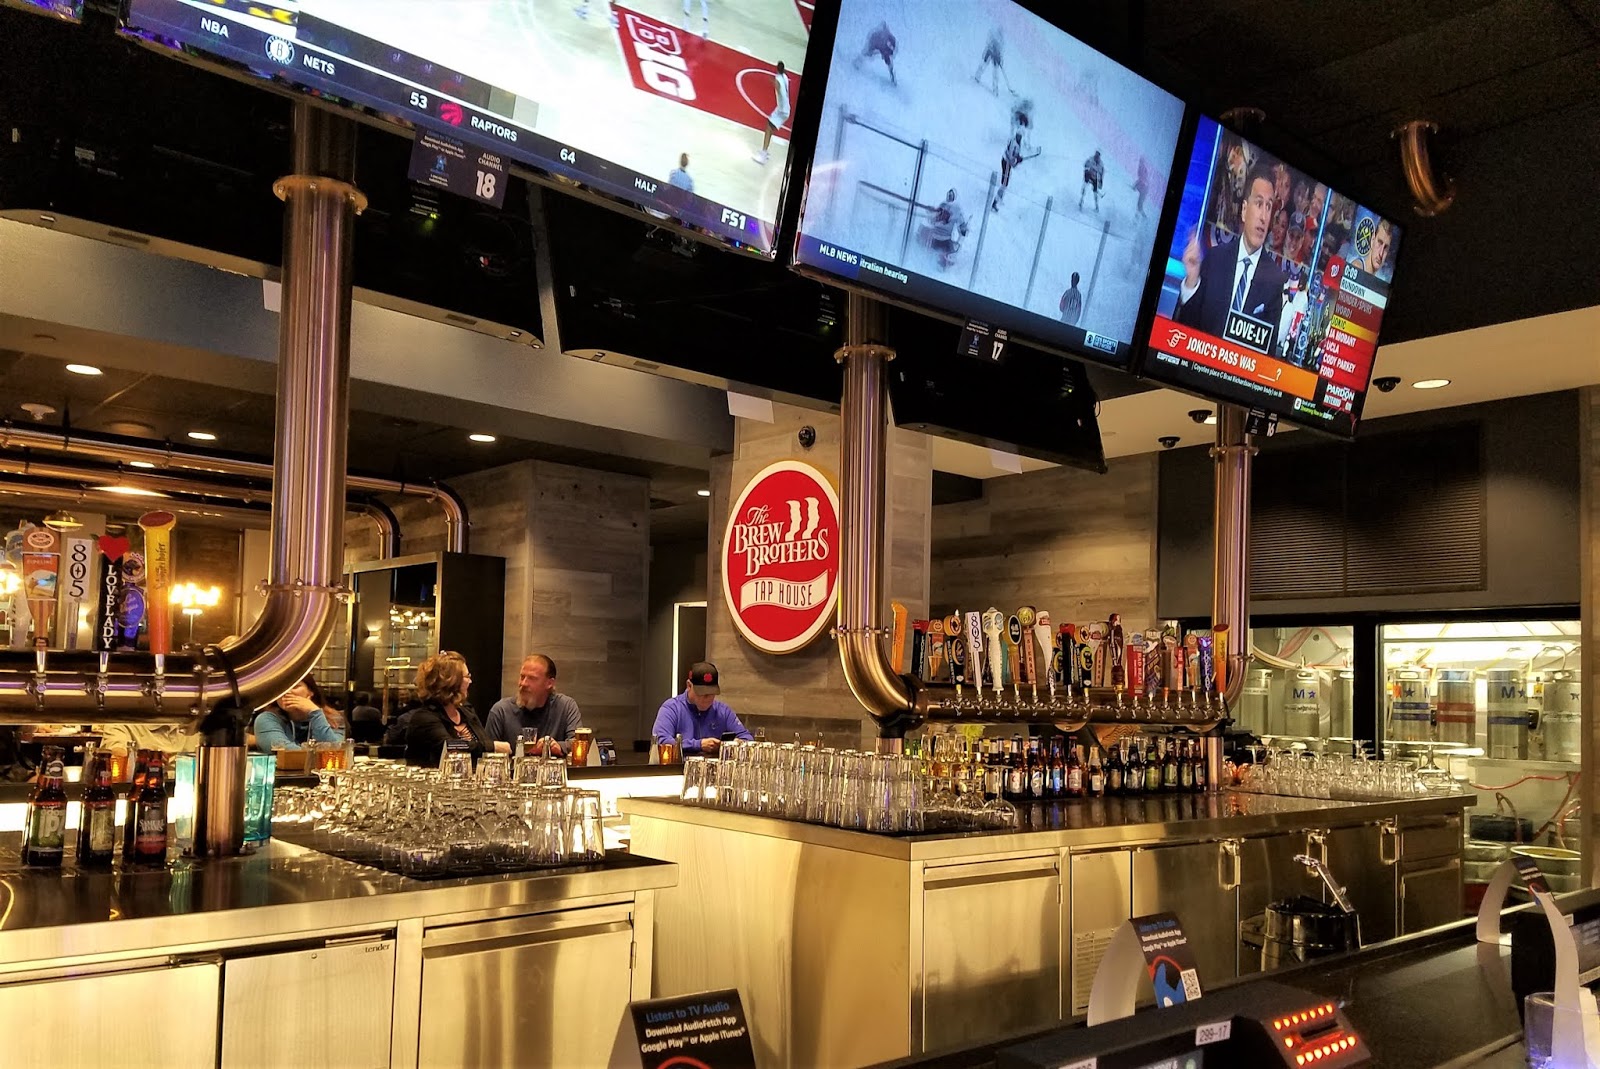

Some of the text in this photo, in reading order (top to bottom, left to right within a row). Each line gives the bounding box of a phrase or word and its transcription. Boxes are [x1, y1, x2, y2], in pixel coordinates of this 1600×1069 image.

[200, 17, 229, 39] NBA
[303, 54, 428, 109] NETS 53
[478, 157, 503, 172] CHANNEL
[482, 152, 501, 164] AUDIO
[470, 116, 518, 142] RAPTORS
[560, 148, 576, 164] 64
[634, 177, 657, 194] HALF
[720, 208, 746, 230] FS1
[475, 170, 496, 199] 18
[820, 244, 836, 257] MLB
[836, 250, 858, 265] NEWS
[884, 267, 908, 284] hearing
[1344, 264, 1358, 280] 0:09
[1341, 277, 1366, 298] RUNDOWN
[1229, 317, 1268, 346] LOVE-LY
[1328, 328, 1356, 347] JA MORANT
[991, 341, 1004, 361] 17
[1186, 337, 1217, 361] JOKIC'S
[1218, 346, 1239, 367] PASS
[1239, 353, 1257, 373] WAS
[1326, 340, 1339, 354] UCLA
[1194, 363, 1209, 374] Coyotes
[1209, 368, 1220, 378] place
[1320, 365, 1334, 378] FORD
[1323, 353, 1356, 373] CODY PARKEY
[1326, 384, 1355, 401] PARDON
[746, 504, 772, 525] The
[734, 521, 784, 554] BREW
[745, 528, 829, 576] BROTHERS
[70, 544, 87, 598] 805
[754, 581, 813, 605] TAP HOUSE
[102, 564, 118, 649] LOVELADY
[971, 615, 981, 649] 805
[365, 943, 391, 953] tender
[645, 1001, 730, 1023] Listen to TV Audio
[645, 1016, 737, 1038] Download AudioFetch App
[1200, 1025, 1228, 1042] 299-17
[641, 1042, 667, 1053] Google
[699, 1032, 720, 1043] Apple
